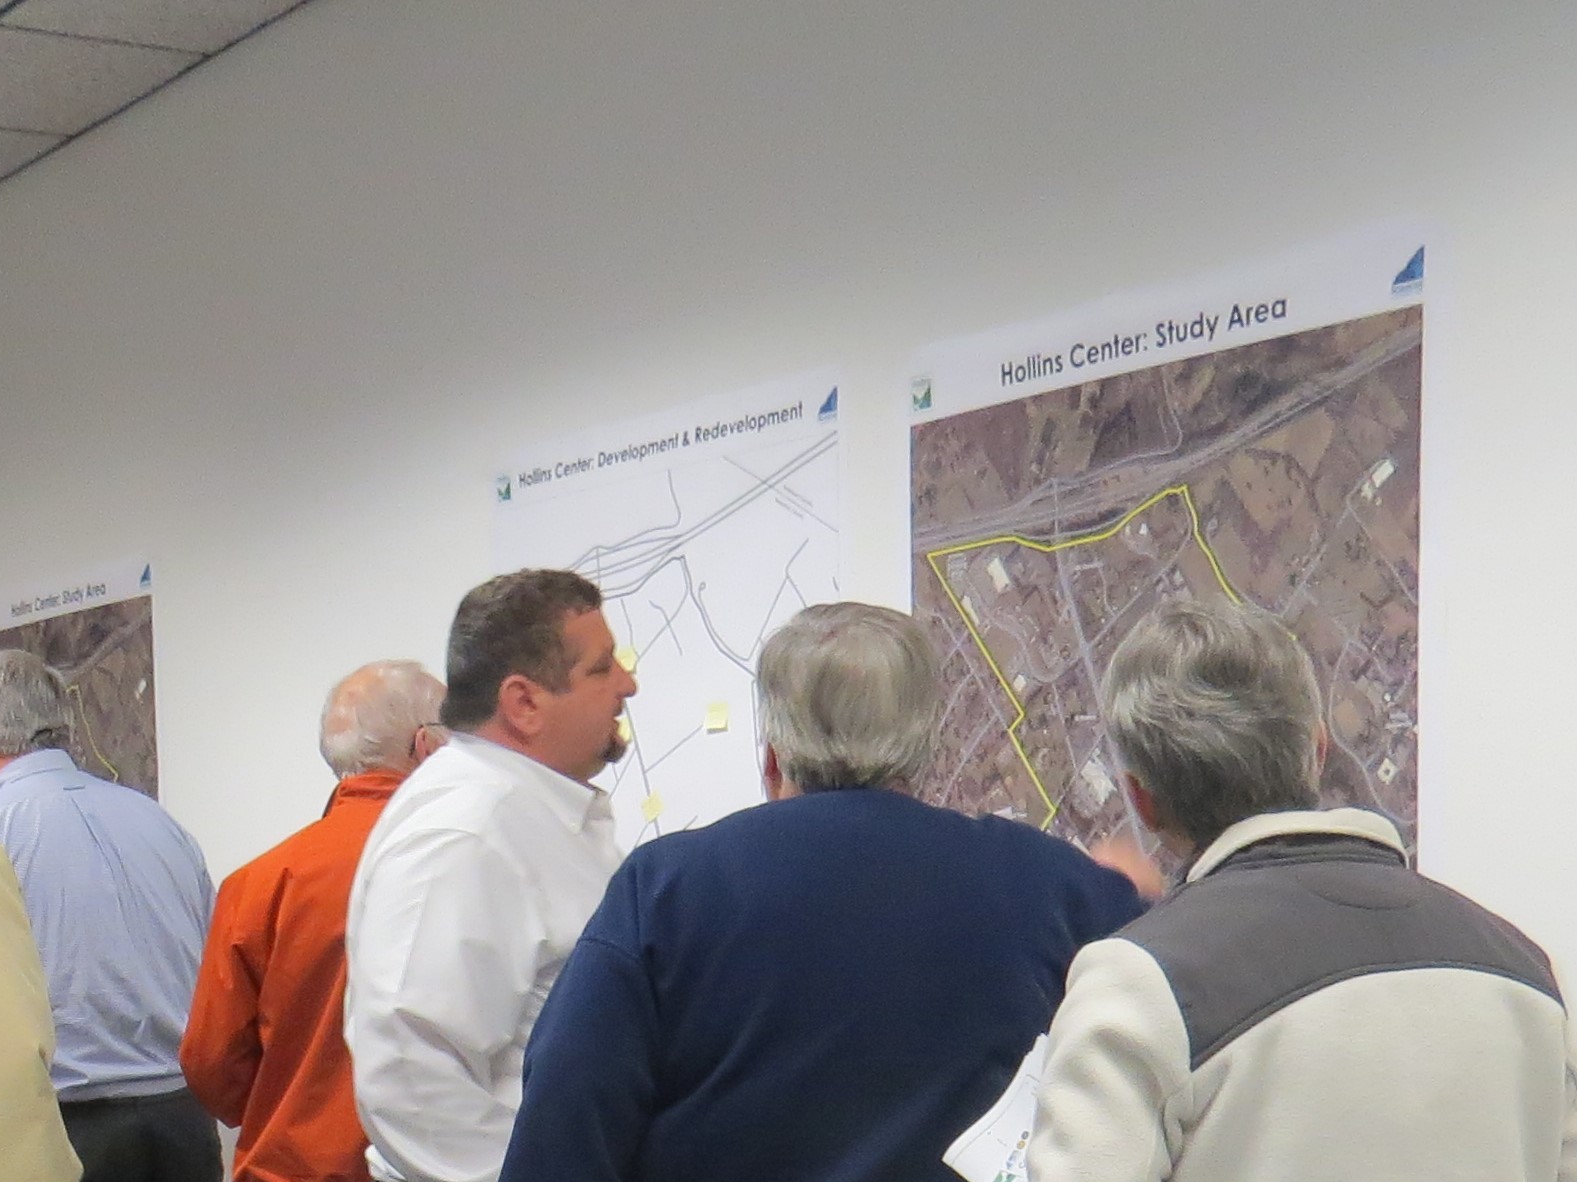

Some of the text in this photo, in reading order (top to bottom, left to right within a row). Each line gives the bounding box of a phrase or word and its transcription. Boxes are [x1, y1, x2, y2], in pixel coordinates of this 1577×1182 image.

[1001, 298, 1287, 387] Hollins Center: Study Area
[518, 467, 552, 488] Hollins
[555, 457, 594, 479] Center:
[598, 433, 679, 468] Development
[682, 431, 691, 447] &
[694, 401, 803, 443] Redevelopment
[86, 582, 106, 598] Area
